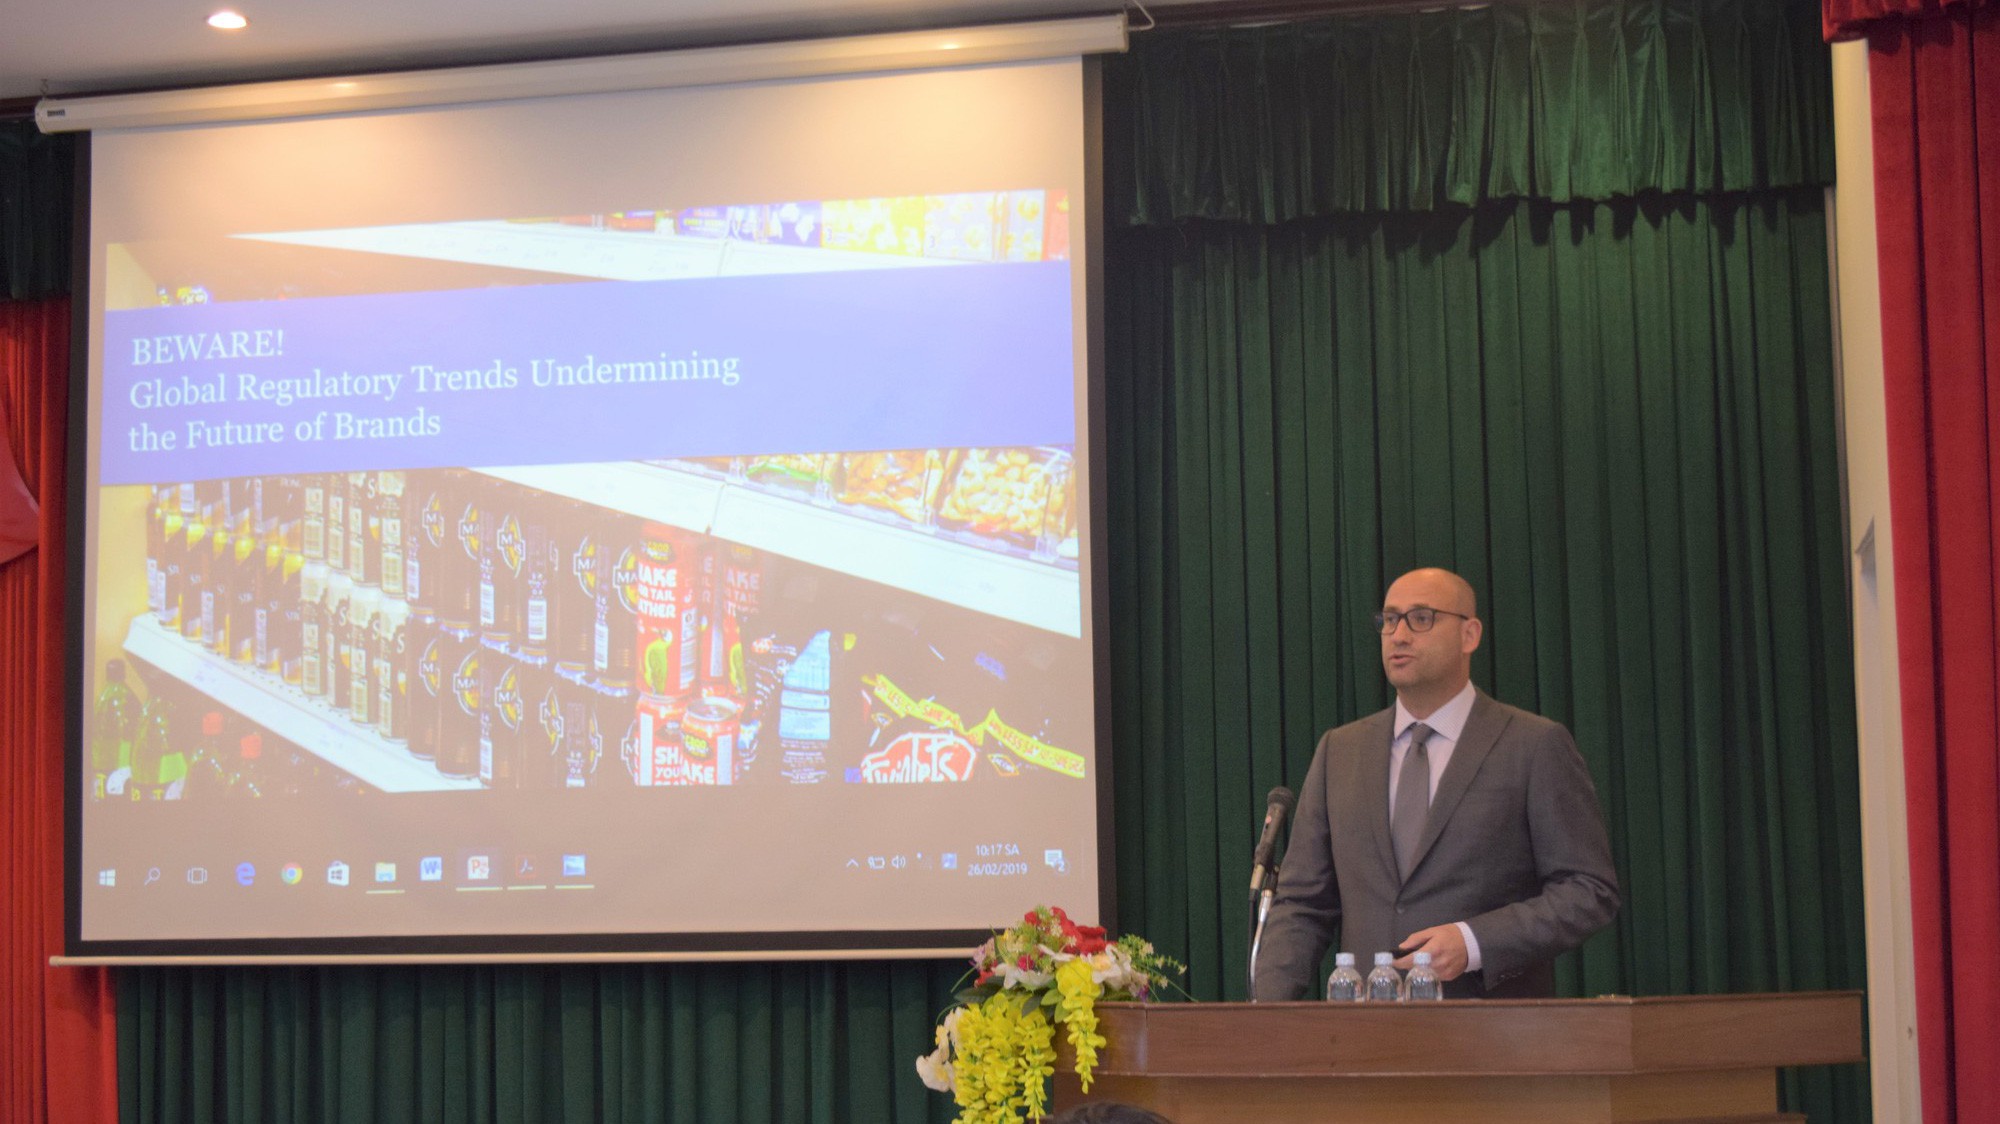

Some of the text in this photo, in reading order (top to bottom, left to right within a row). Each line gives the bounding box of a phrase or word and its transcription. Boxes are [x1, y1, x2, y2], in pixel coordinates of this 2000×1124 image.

[130, 328, 284, 366] BEWARE!
[129, 350, 741, 409] Global Regulatory Trends Undermining
[127, 407, 442, 453] the Future of Brands
[975, 843, 1020, 857] 10:17 SA
[967, 862, 1028, 877] 26/02/2019
